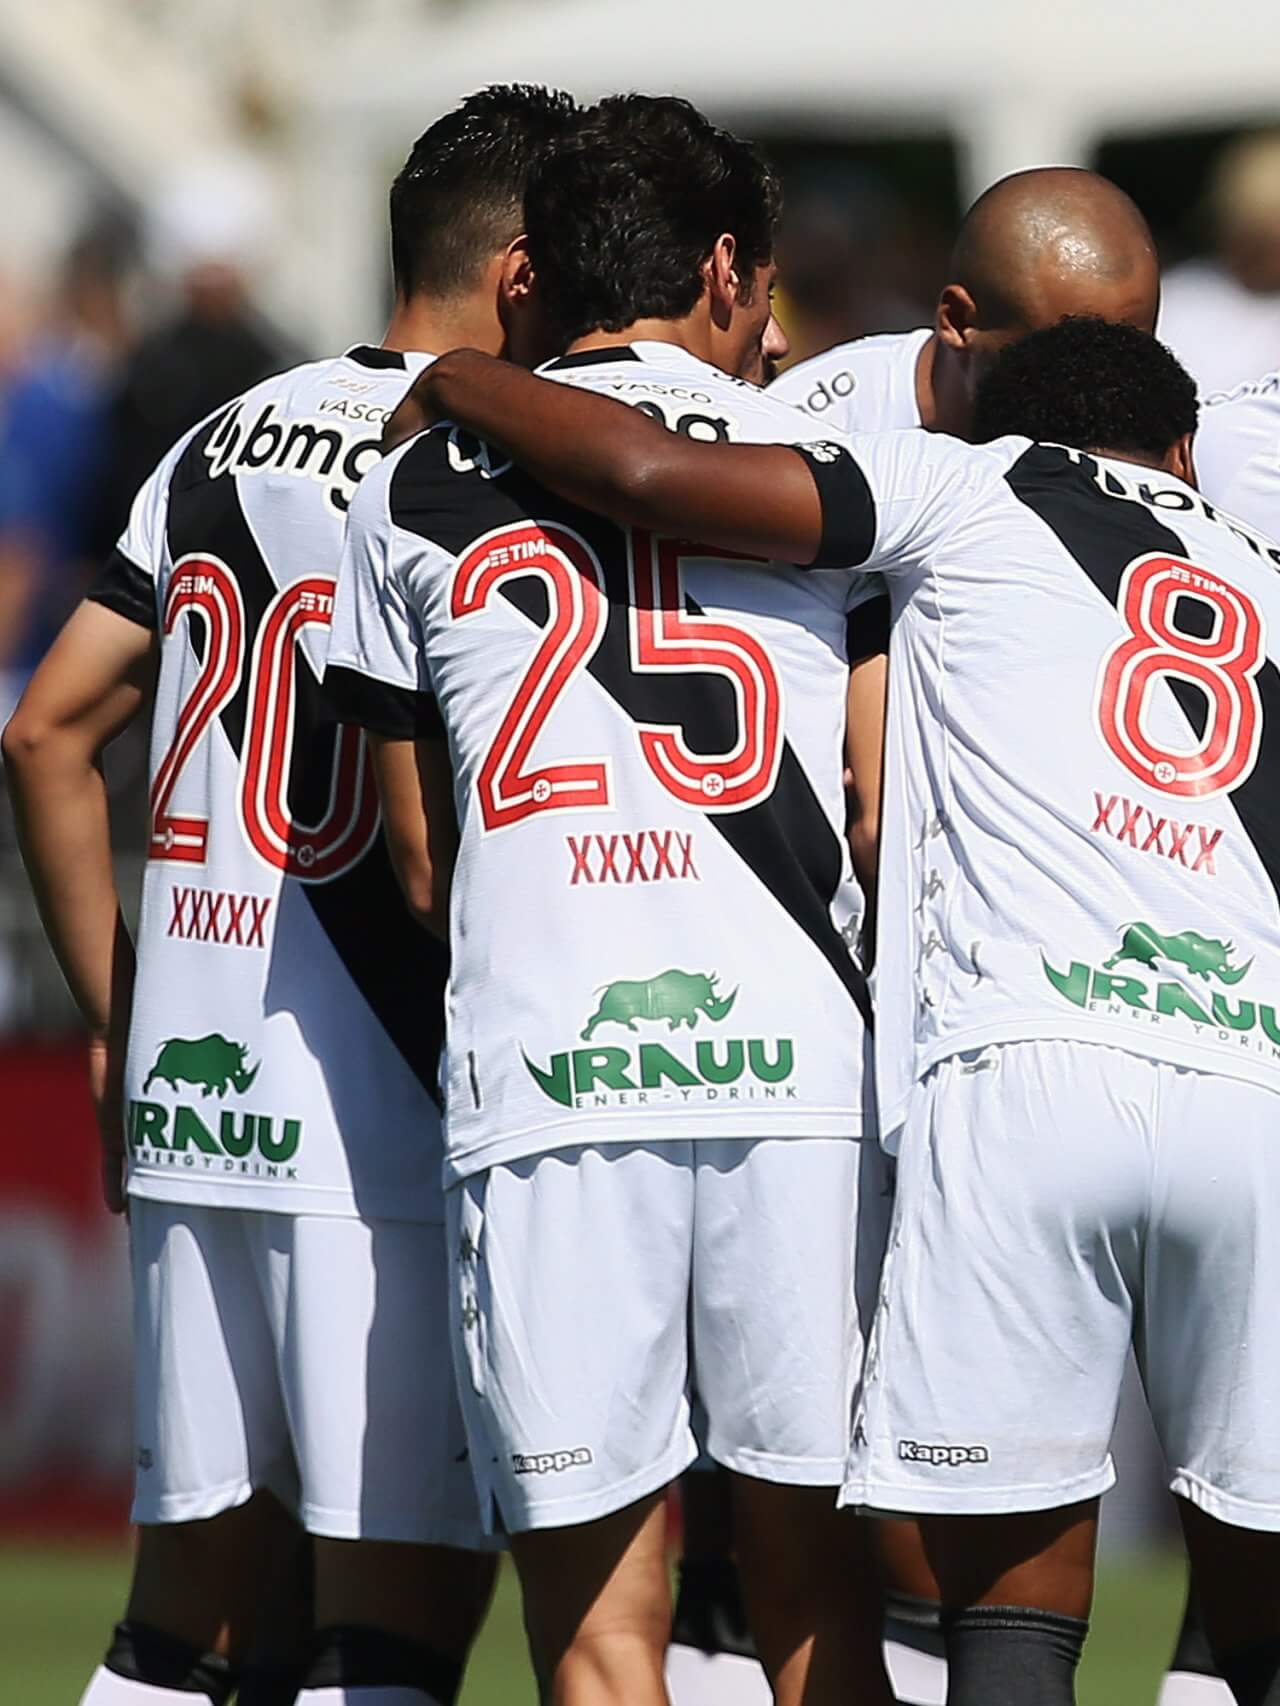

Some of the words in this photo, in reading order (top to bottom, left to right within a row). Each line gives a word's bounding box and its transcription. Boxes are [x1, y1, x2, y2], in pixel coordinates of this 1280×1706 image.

[509, 538, 547, 563] TIM
[1190, 573, 1228, 596] TIM
[450, 519, 786, 838] 25
[1094, 551, 1266, 800] 8
[149, 553, 382, 885] 20
[1090, 791, 1224, 876] XXXXX
[567, 830, 700, 886] XXXXX
[168, 886, 272, 948] XXXXX
[706, 1085, 798, 1104] DRINK
[224, 1155, 299, 1180] DRINK
[513, 1446, 593, 1474] Kappa
[899, 1440, 989, 1467] Kappa
